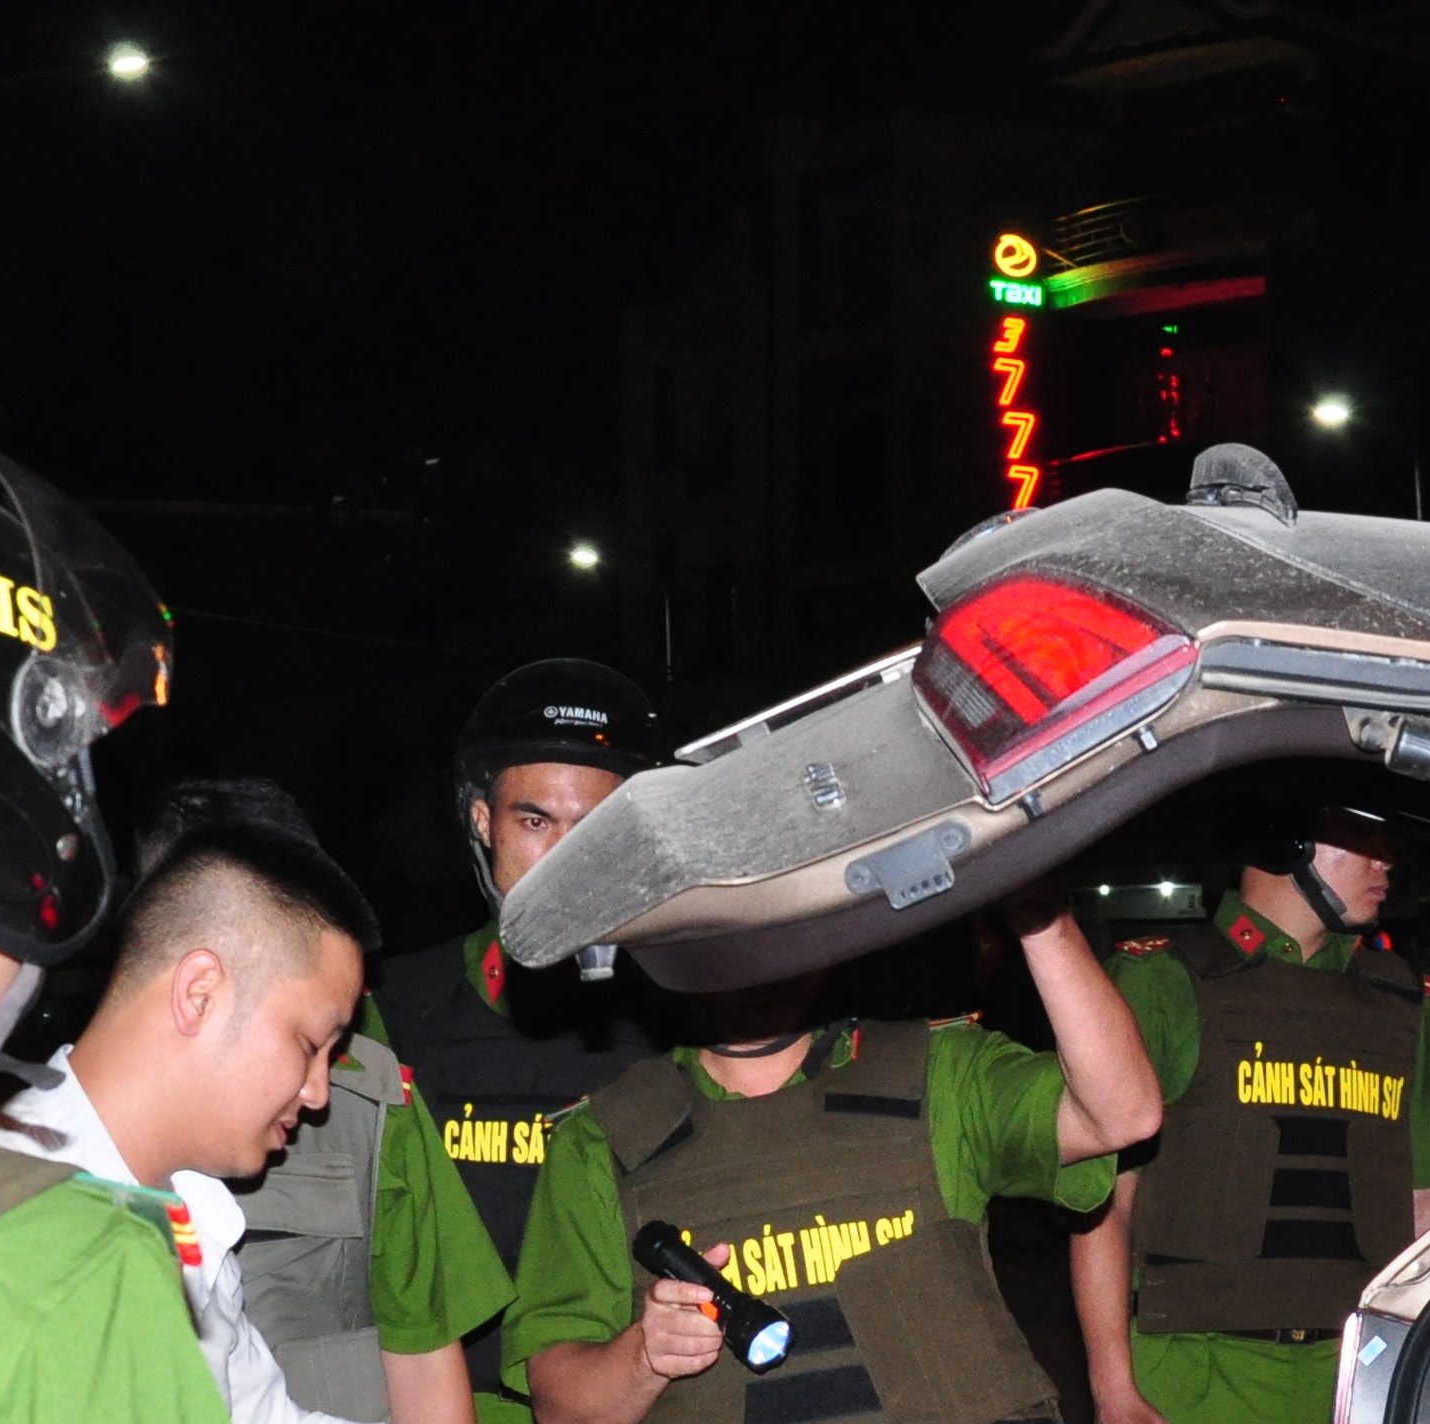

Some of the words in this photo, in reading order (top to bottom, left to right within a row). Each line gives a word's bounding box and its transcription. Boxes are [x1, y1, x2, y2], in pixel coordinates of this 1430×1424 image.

[558, 706, 608, 724] YAMAHA
[1238, 1041, 1295, 1105] CẢNH
[1300, 1057, 1335, 1107] SÁT
[1340, 1060, 1379, 1115] HÌNH
[444, 1103, 508, 1163] CẢNH
[512, 1113, 553, 1164] SÁ
[742, 1224, 798, 1296] SÁT
